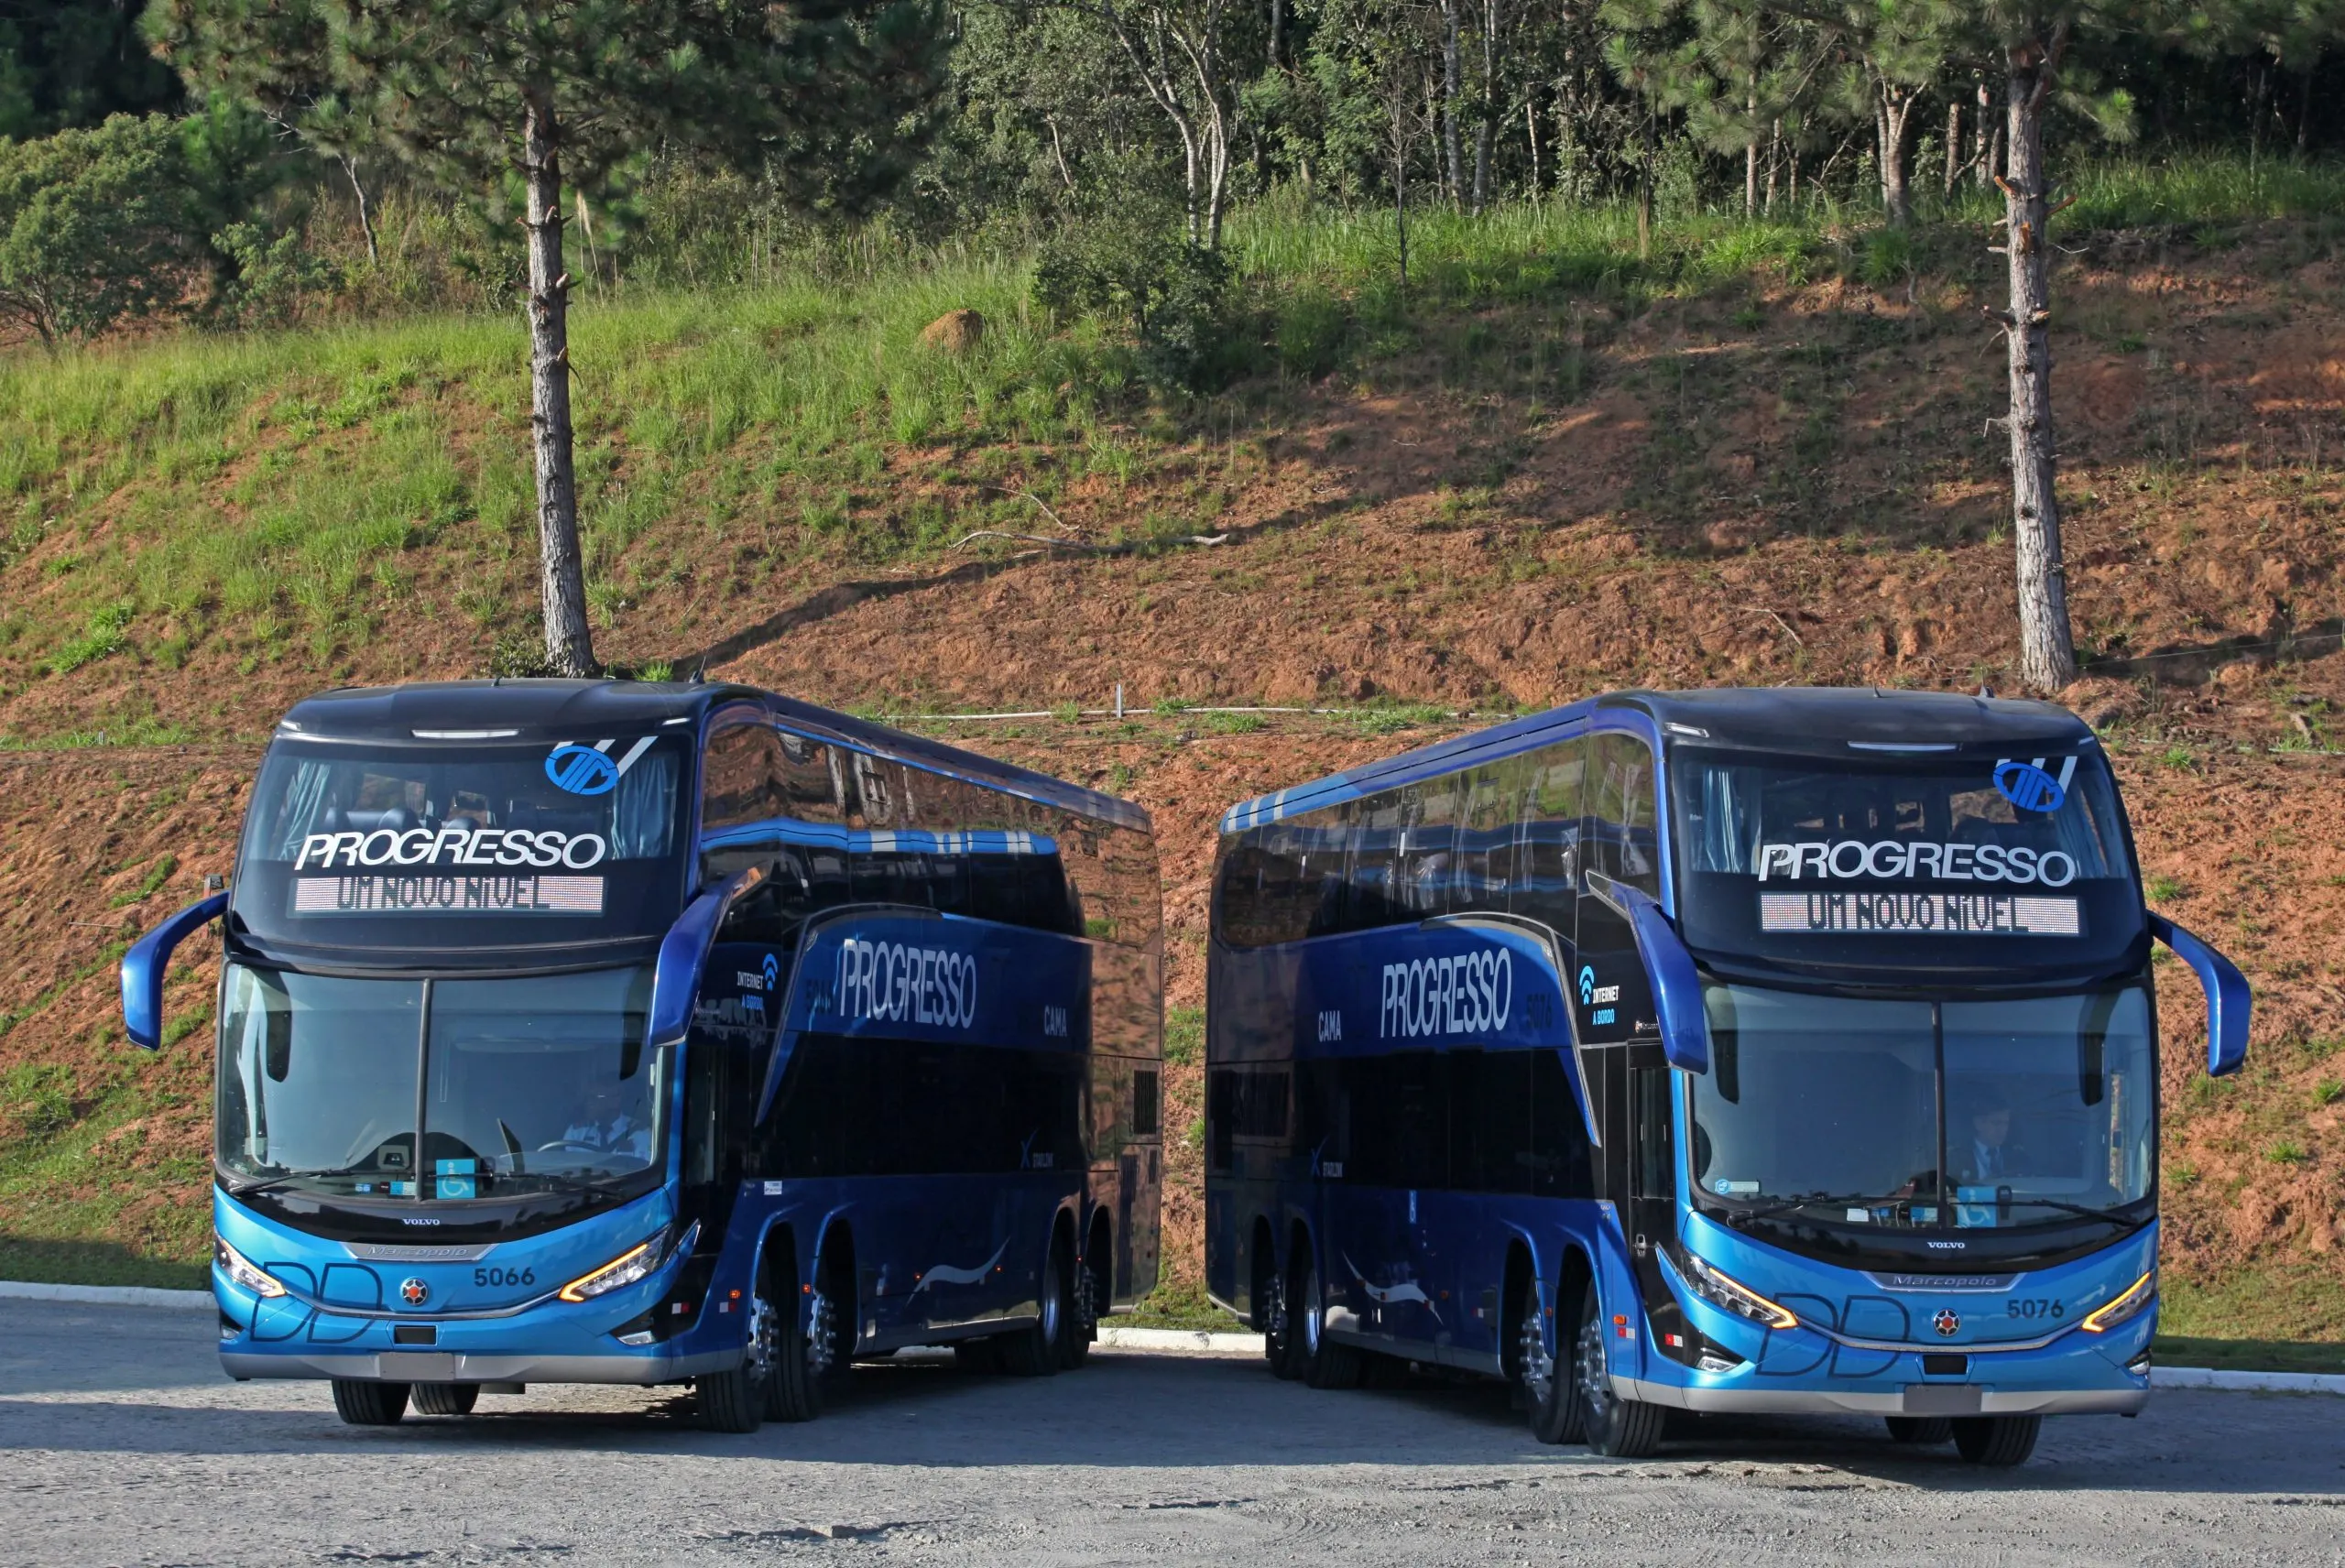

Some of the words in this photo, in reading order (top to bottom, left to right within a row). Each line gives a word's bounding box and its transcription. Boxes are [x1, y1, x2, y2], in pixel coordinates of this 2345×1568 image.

[295, 828, 606, 870] PROGRESSO
[1758, 840, 2076, 887] PROGRESSO
[337, 877, 375, 909] UM
[380, 877, 458, 909] NOVO
[1807, 893, 1847, 929] UM
[1856, 893, 1935, 929] NOVO
[736, 971, 764, 990] INTERNET
[840, 938, 977, 1029] PROGRESSO
[741, 994, 746, 1008] A
[1380, 947, 1511, 1038] PROGRESSO
[1592, 985, 1620, 1004] INTERNET
[1043, 1005, 1068, 1037] CAMA
[1318, 1010, 1342, 1042] CAMA
[1592, 1010, 1598, 1025] A
[1598, 1008, 1615, 1025] BORDO
[366, 1246, 469, 1258] Marcopolo
[1927, 1241, 1965, 1249] VOLVO
[474, 1267, 535, 1288] 5066
[1892, 1274, 1997, 1287] Marcopolo
[2006, 1299, 2065, 1319] 5076
